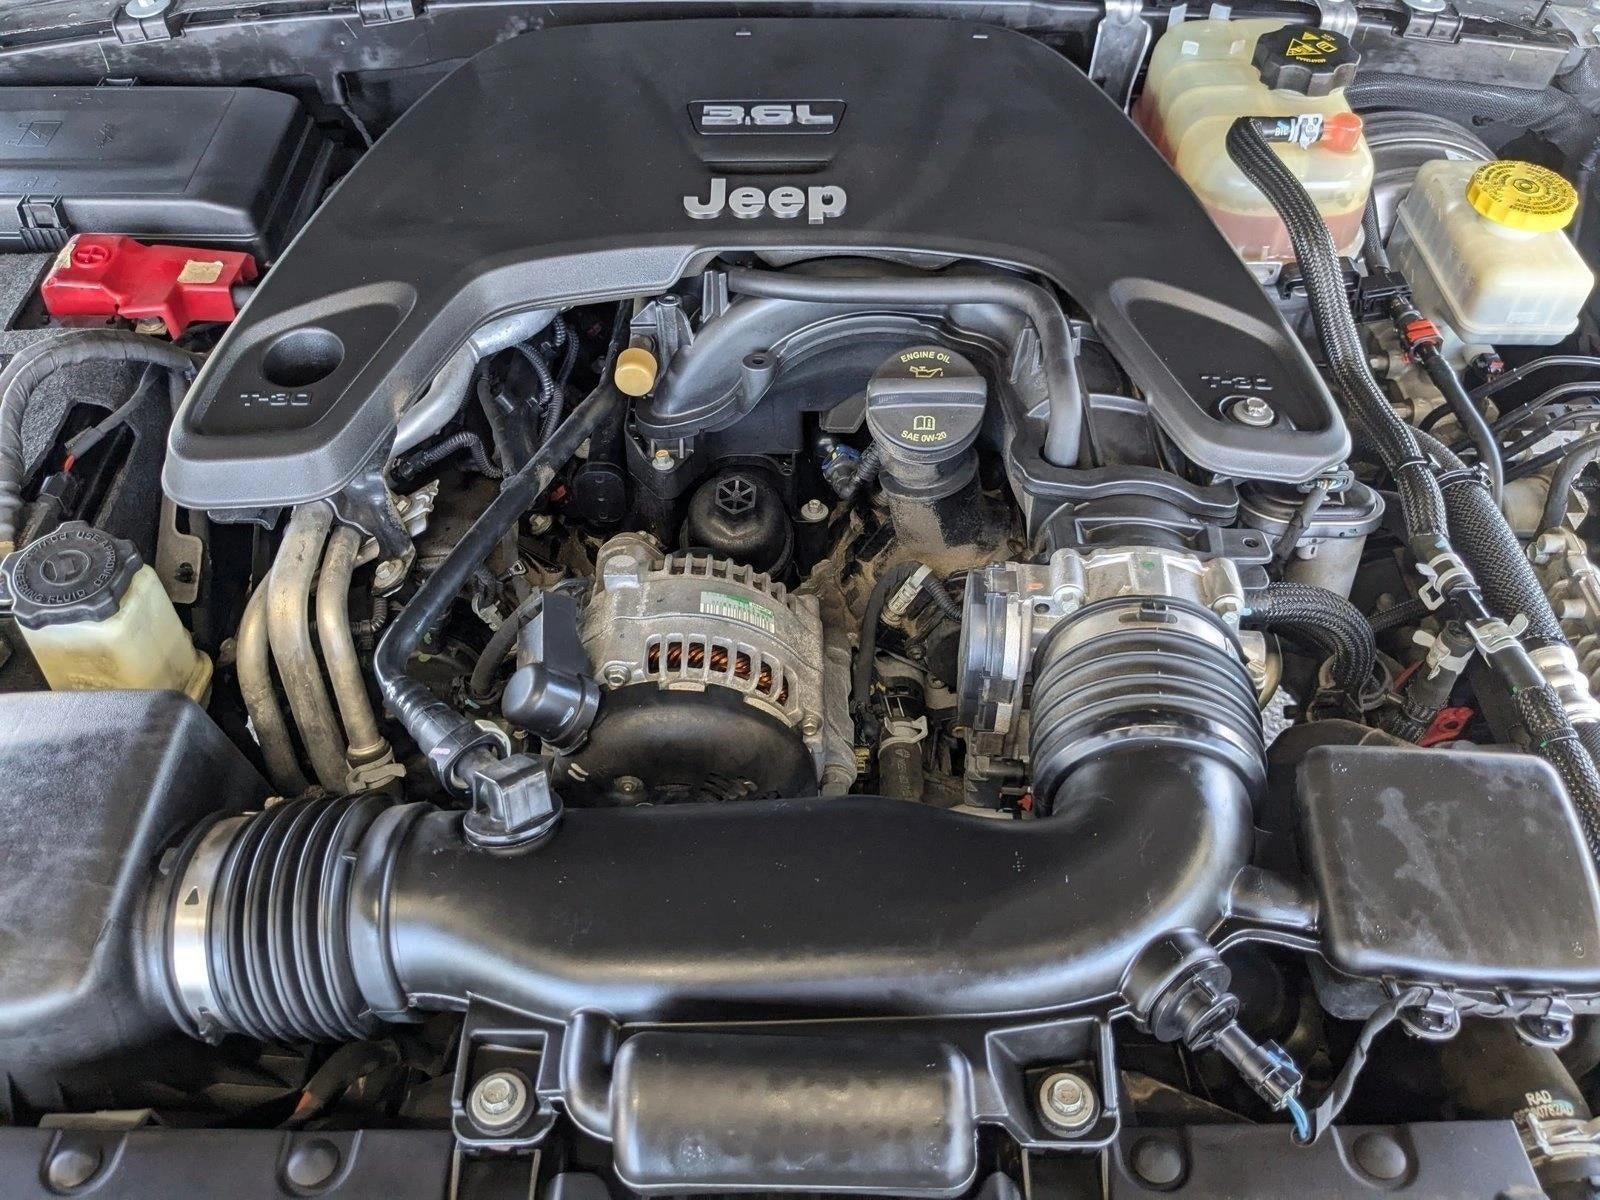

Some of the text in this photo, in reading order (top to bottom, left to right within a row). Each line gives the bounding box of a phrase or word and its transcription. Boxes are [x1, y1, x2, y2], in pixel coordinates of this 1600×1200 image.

[701, 104, 834, 126] 3.6L
[683, 178, 847, 225] Jeep
[900, 351, 952, 364] ENGINE OIL
[901, 430, 947, 442] SAE 0W-20
[76, 531, 118, 587] USE APPROVED
[15, 561, 45, 603] STEERING
[47, 588, 86, 605] FLUID
[1525, 1089, 1552, 1106] RAD
